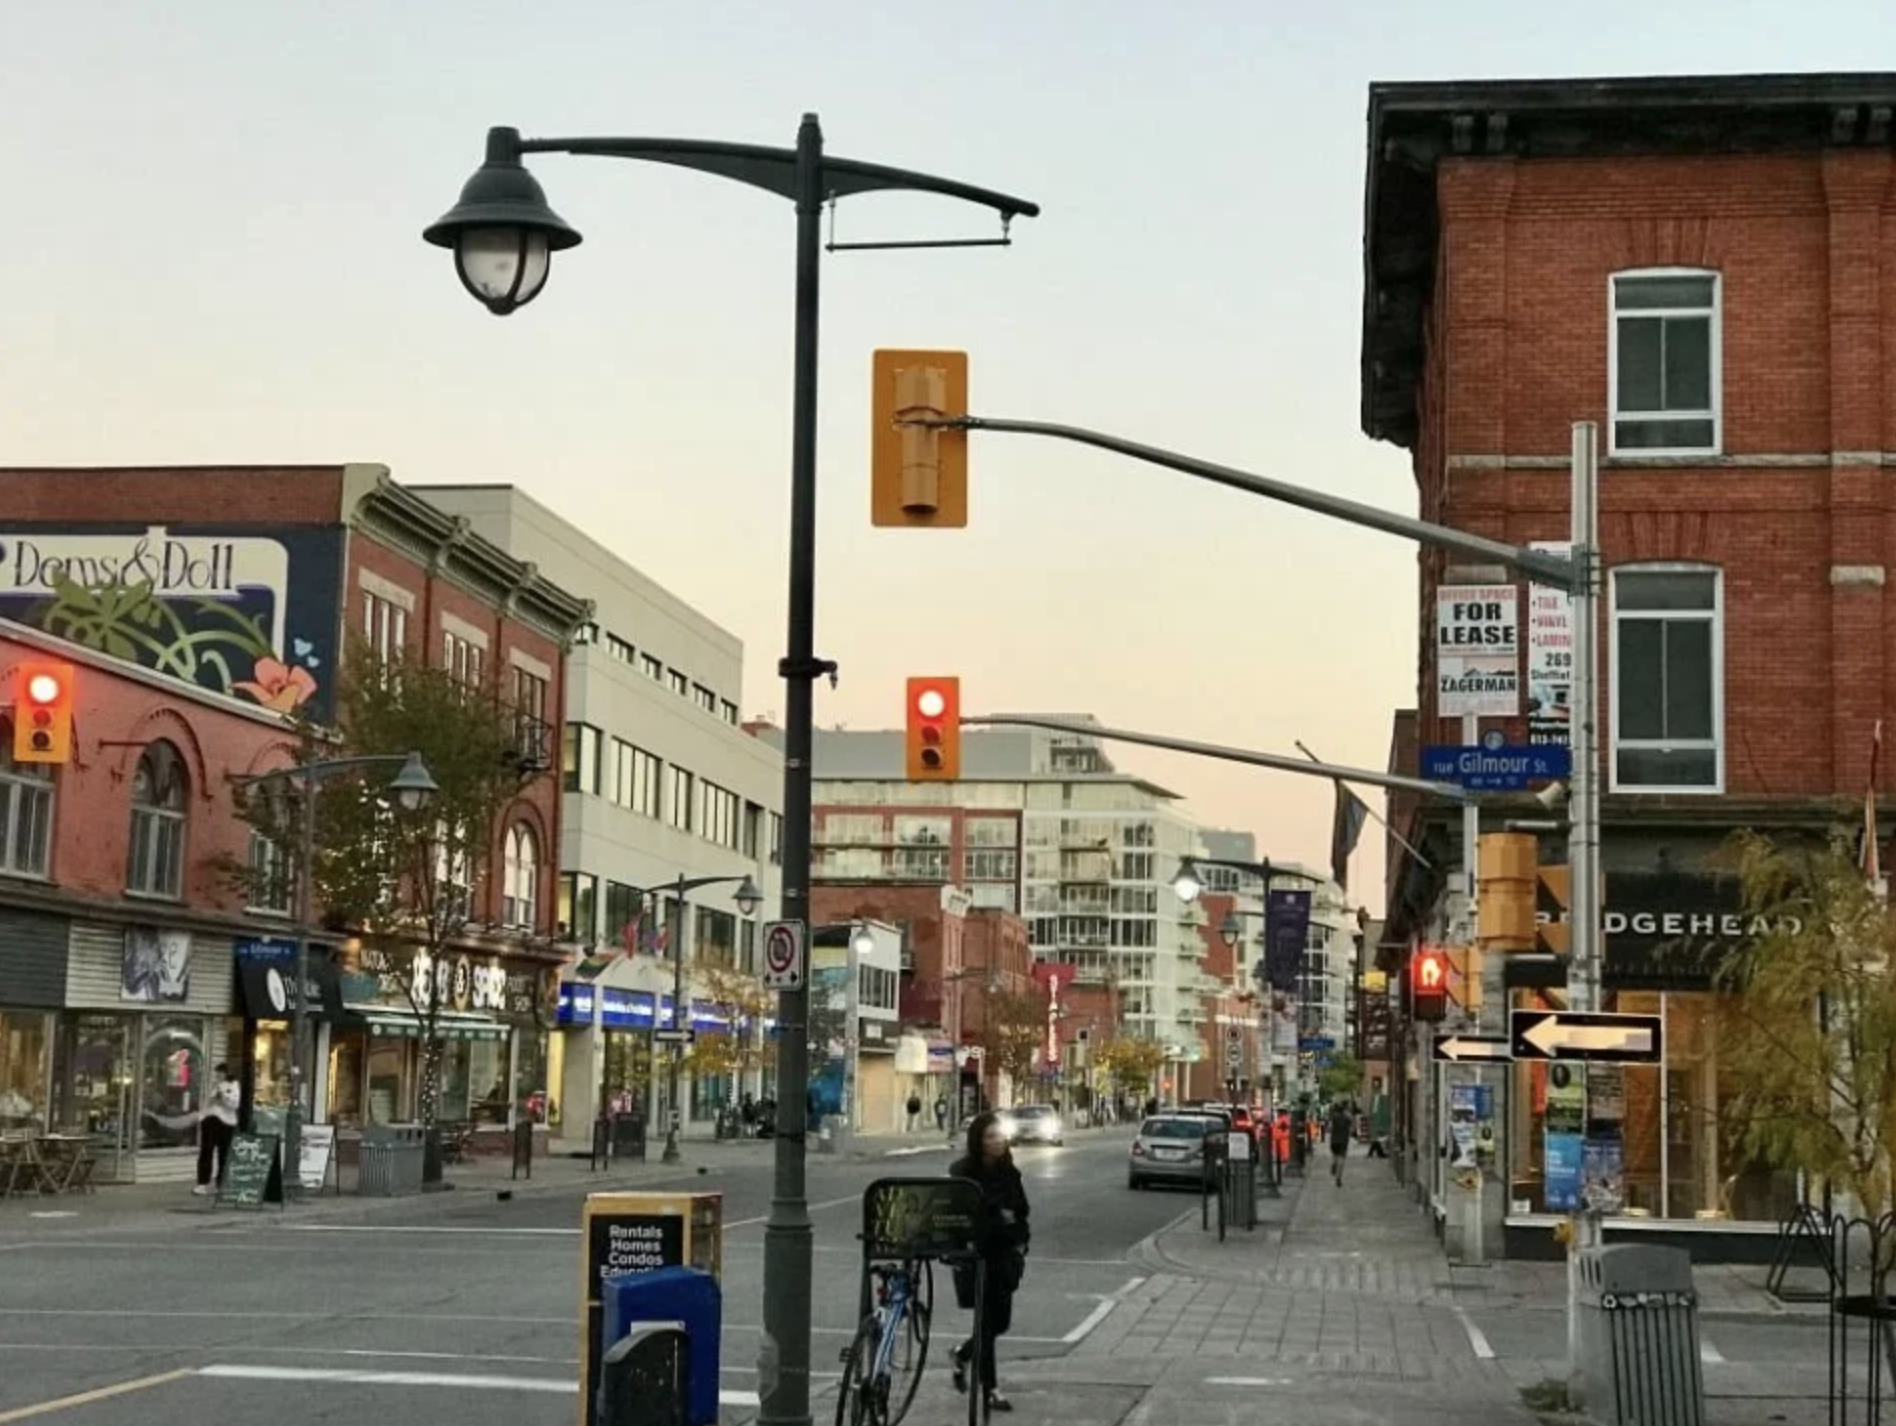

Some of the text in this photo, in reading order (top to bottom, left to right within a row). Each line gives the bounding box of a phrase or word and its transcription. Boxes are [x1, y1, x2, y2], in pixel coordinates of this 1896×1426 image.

[1453, 602, 1502, 621] FOR
[1440, 625, 1515, 645] LEASE
[1440, 678, 1516, 693] ZAGERMAN
[1433, 762, 1454, 774] rue
[1459, 752, 1529, 773] Gilmour
[609, 1225, 663, 1239] Rentals
[610, 1239, 662, 1252] Homes
[608, 1252, 664, 1265] Condos
